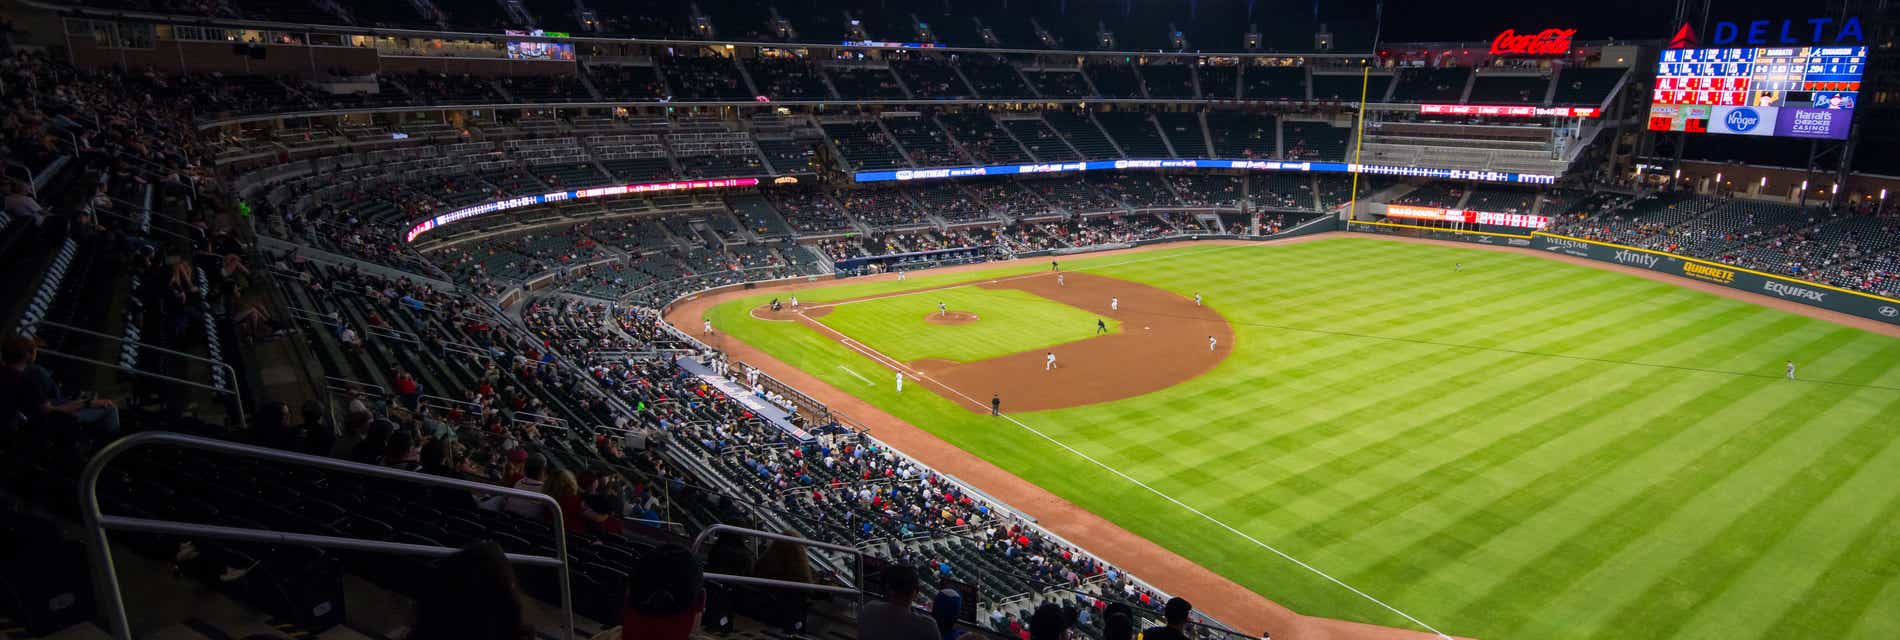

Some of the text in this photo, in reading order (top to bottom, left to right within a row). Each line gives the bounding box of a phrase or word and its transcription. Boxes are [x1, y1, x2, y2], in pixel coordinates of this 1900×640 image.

[1713, 16, 1865, 45] DELTA
[1488, 28, 1578, 55] Coca-Cola
[1664, 50, 1677, 62] NL
[1660, 78, 1672, 89] AL
[1727, 108, 1758, 131] Kroger
[1546, 236, 1589, 249] WELLSTAR
[1614, 249, 1659, 268] xfinity
[1682, 261, 1736, 282] QUIKRETE
[1764, 281, 1825, 301] EQUIFAX
